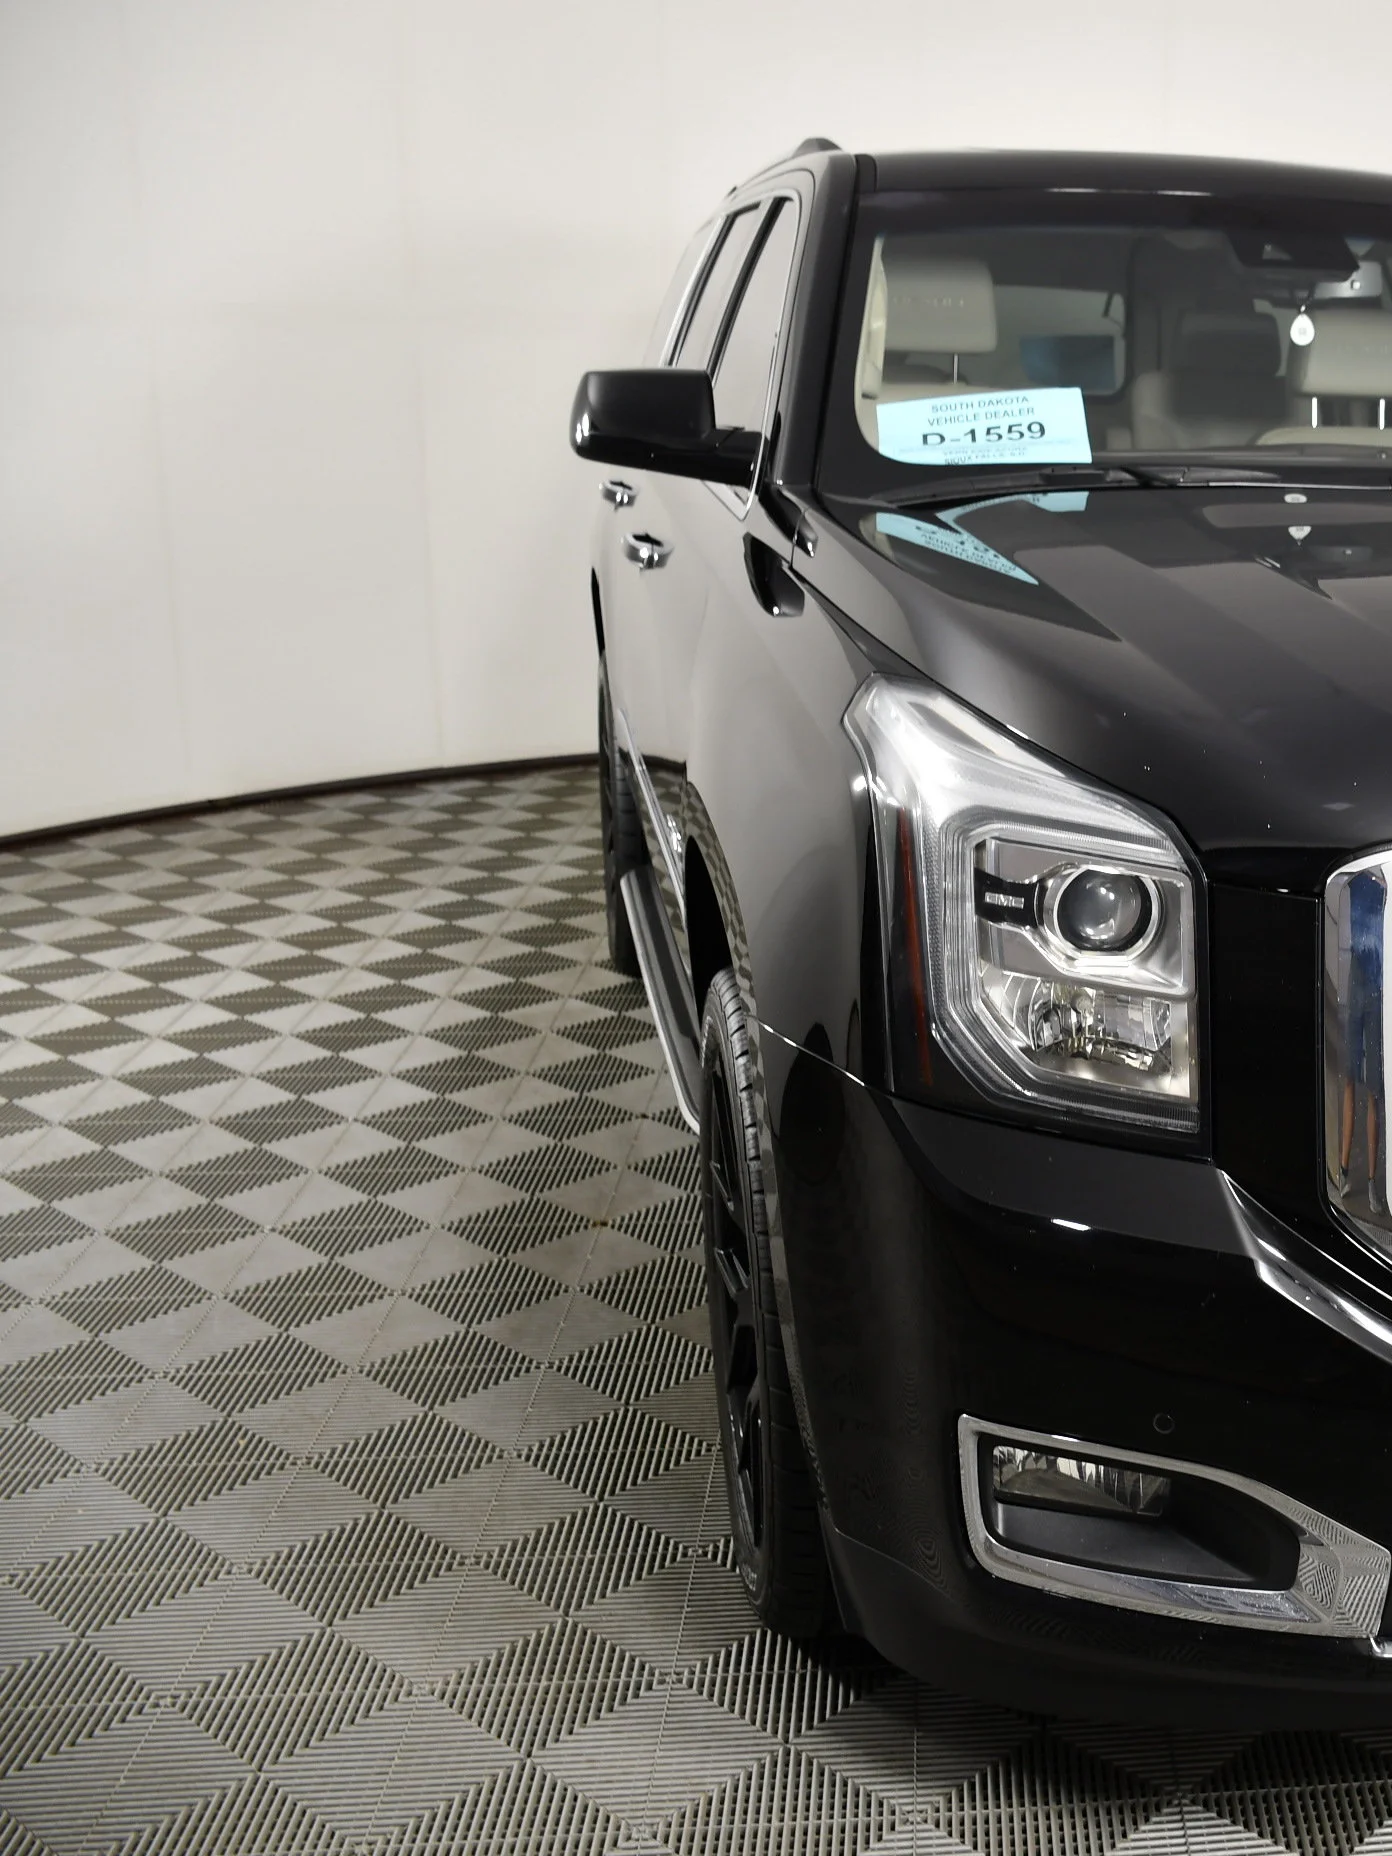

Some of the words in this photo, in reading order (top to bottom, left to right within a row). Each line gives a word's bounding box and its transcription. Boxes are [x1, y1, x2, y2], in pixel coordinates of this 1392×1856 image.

[931, 403, 974, 413] SOUTH
[978, 396, 1029, 408] DAKOTA
[927, 413, 980, 426] VEHICLE
[985, 407, 1035, 420] DEALER
[922, 421, 1046, 446] D-1559
